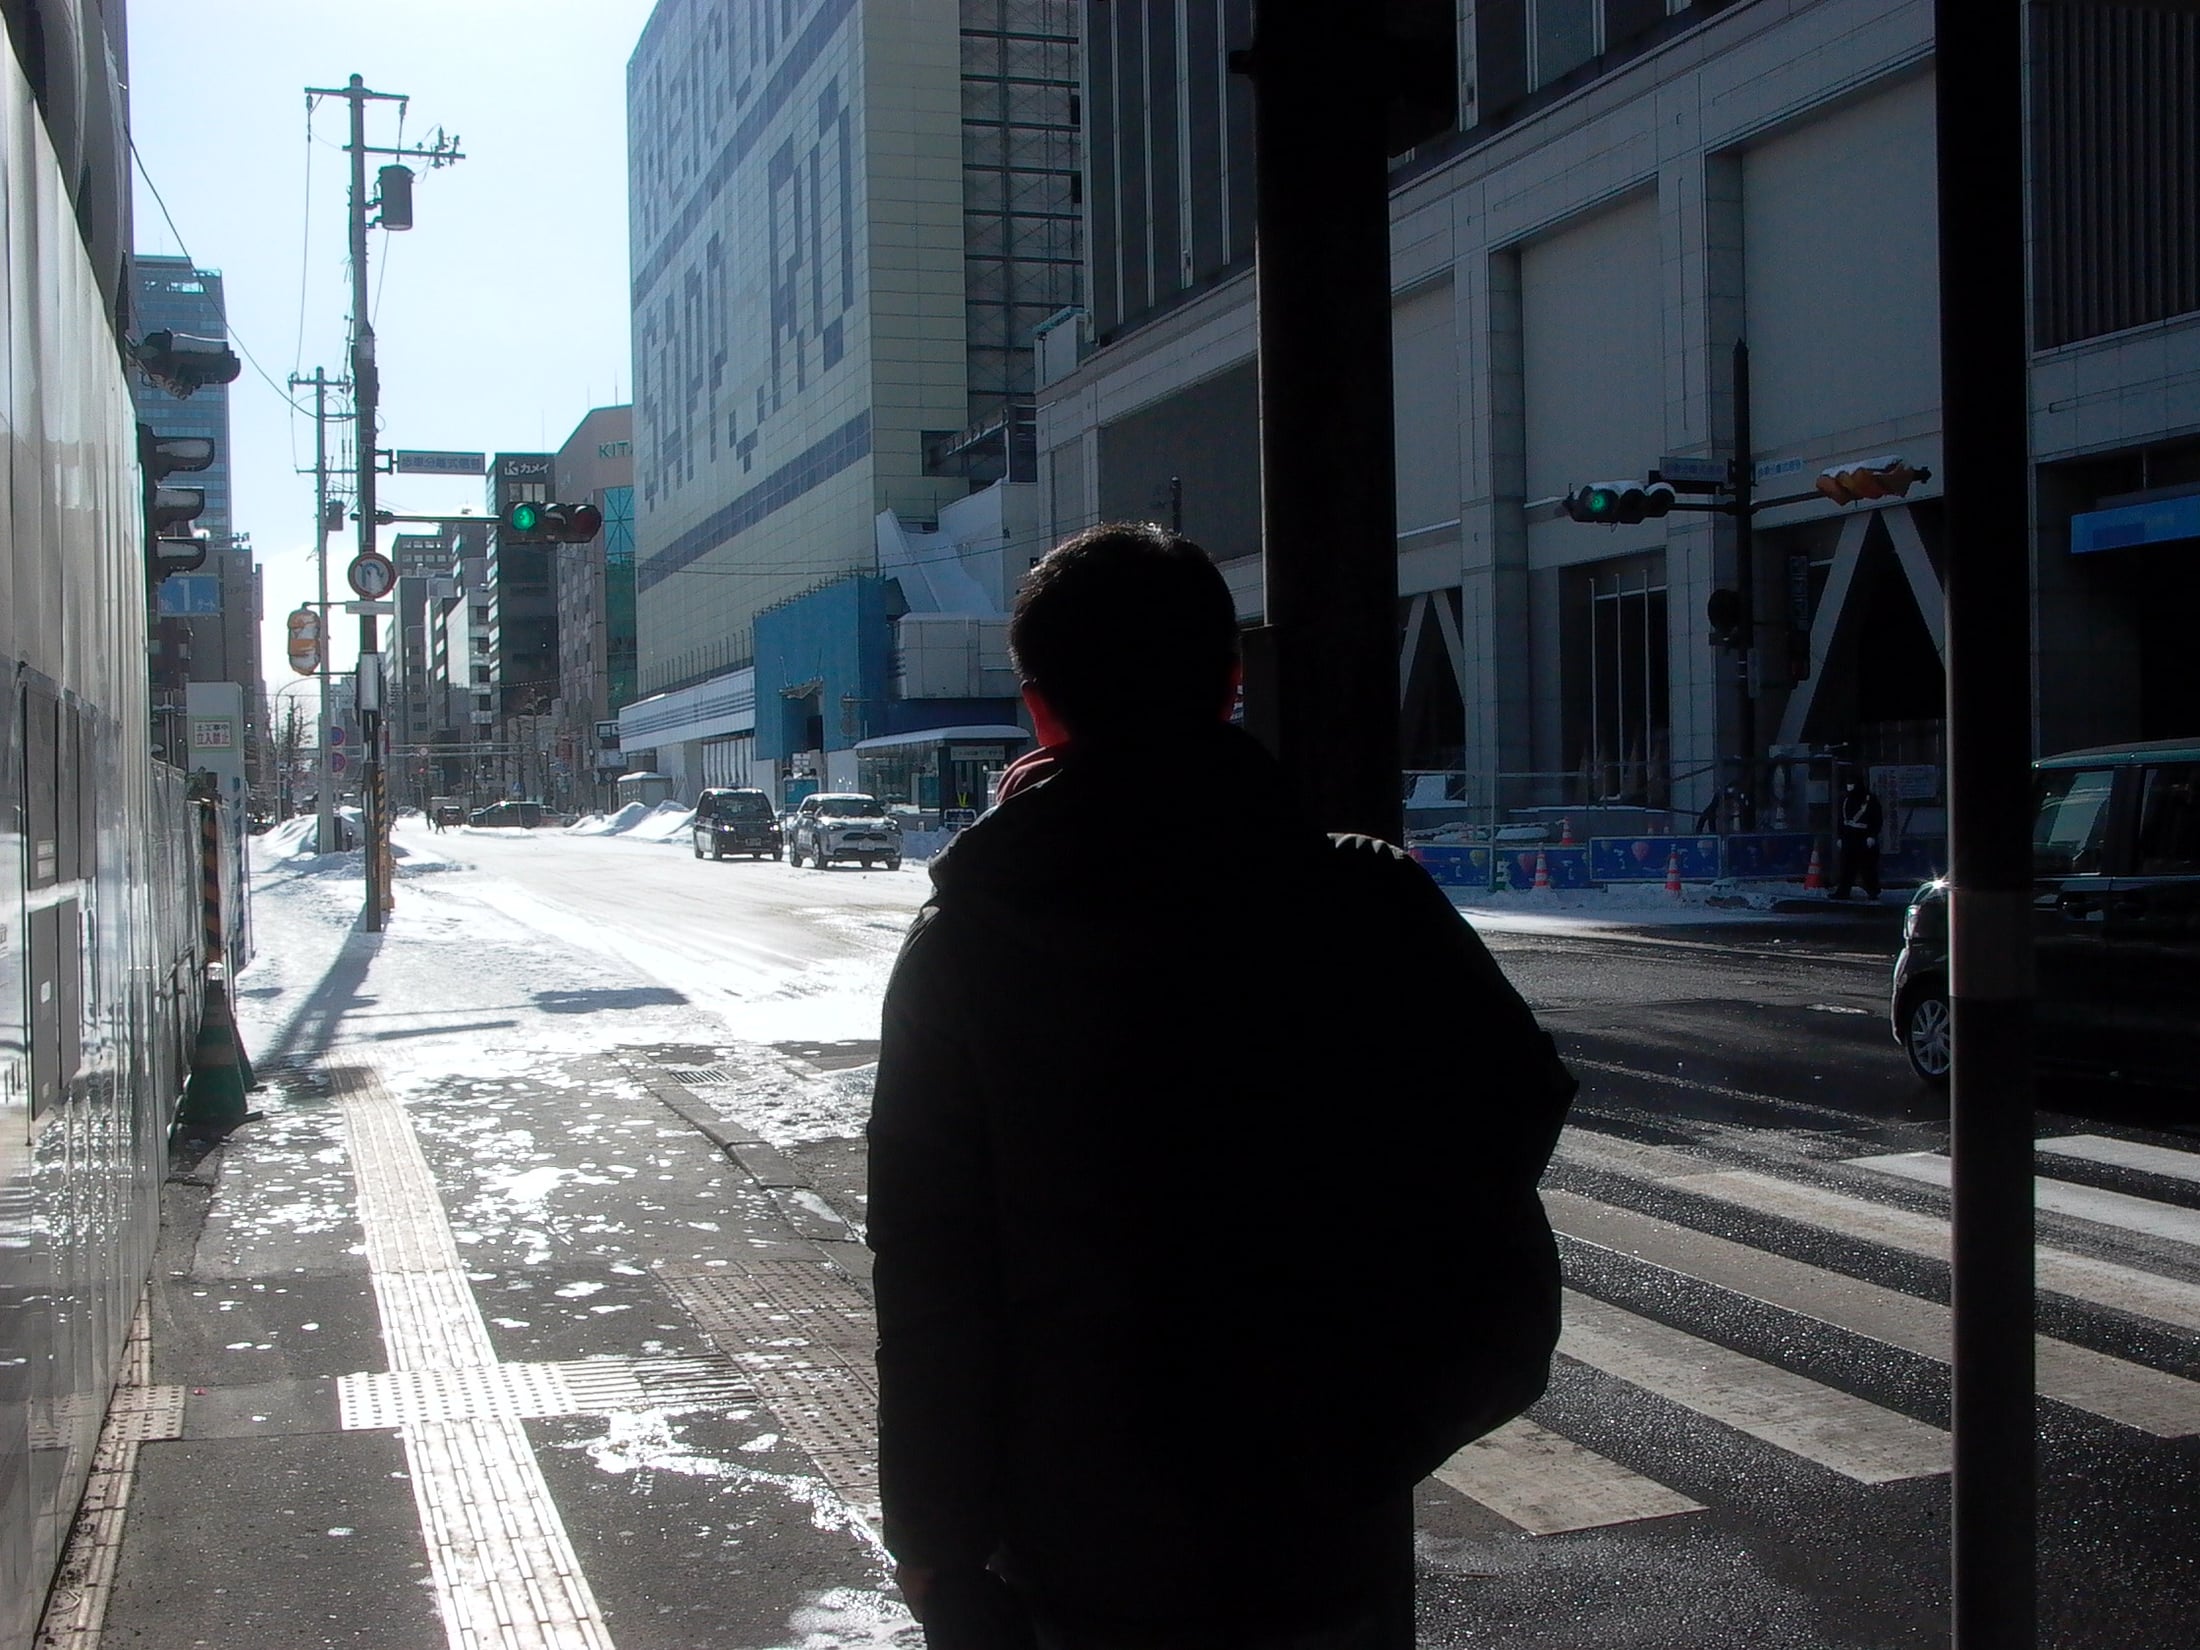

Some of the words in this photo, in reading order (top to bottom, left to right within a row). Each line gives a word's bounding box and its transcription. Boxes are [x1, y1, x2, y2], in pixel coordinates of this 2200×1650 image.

[519, 463, 549, 475] カメイ
[196, 732, 230, 745] 立入禁止
